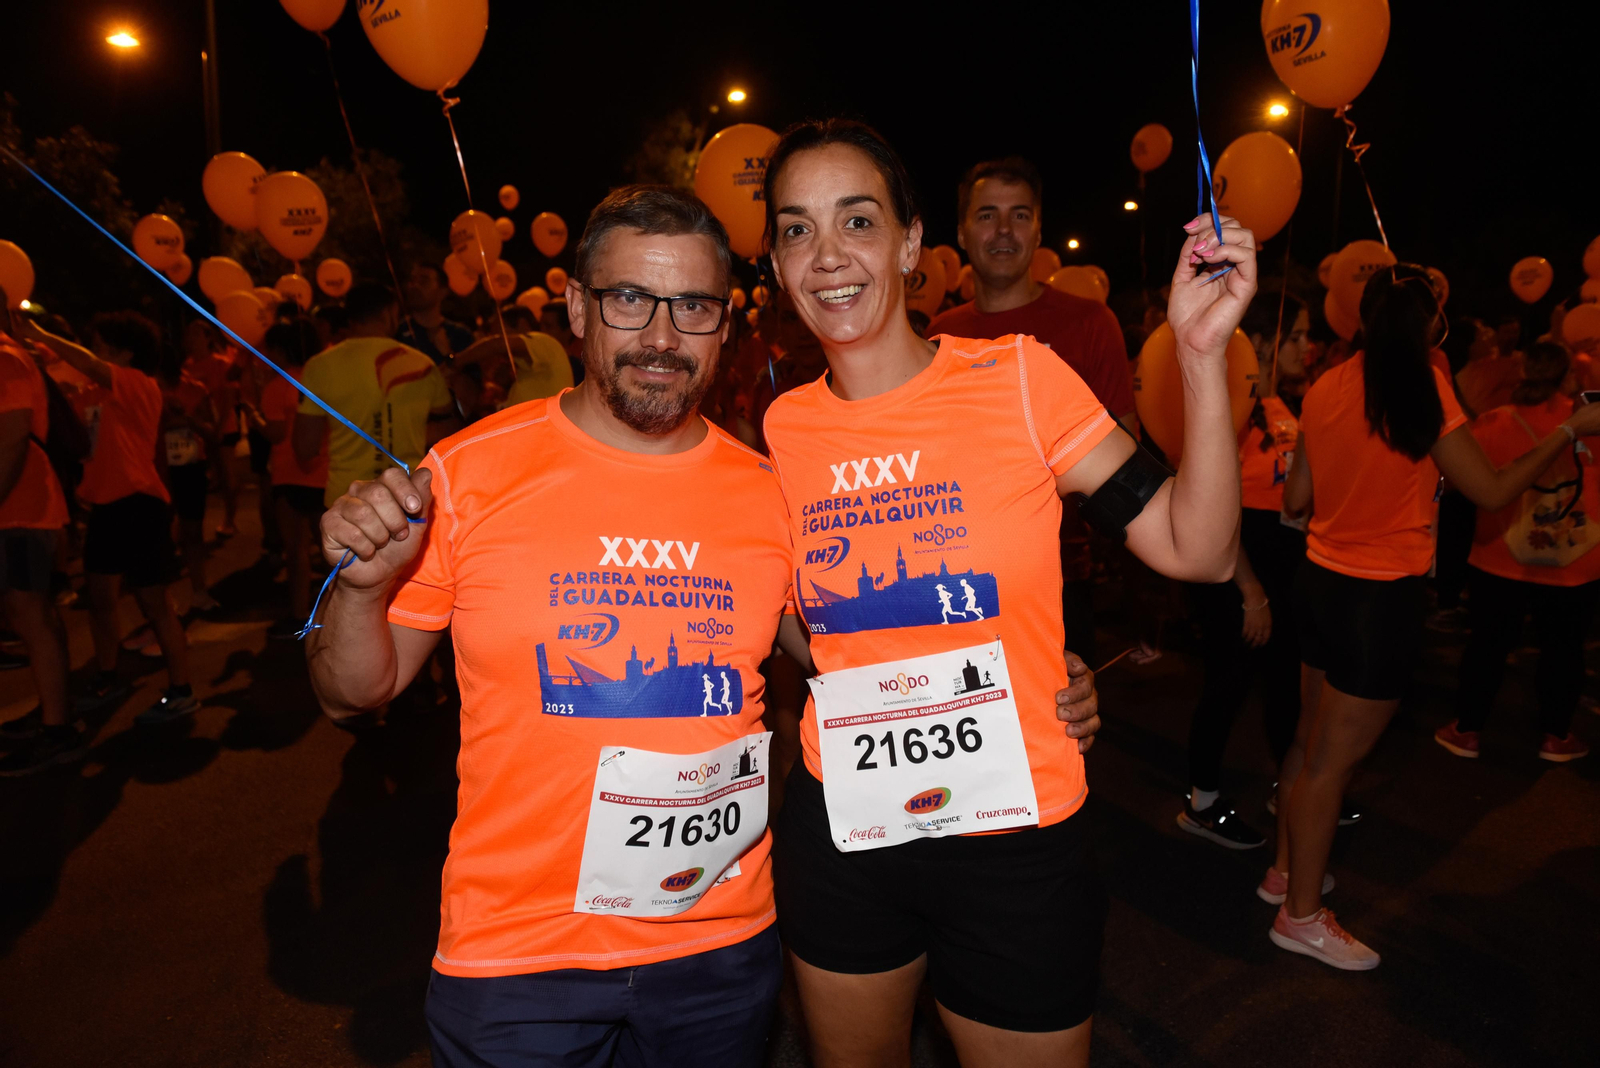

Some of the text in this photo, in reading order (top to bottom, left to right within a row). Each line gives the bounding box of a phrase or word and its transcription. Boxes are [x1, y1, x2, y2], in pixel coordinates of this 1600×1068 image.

[829, 450, 921, 494] XXXV
[802, 480, 962, 517] CARRERA NOCTURNA
[809, 497, 965, 533] GUADALQUIVIR
[598, 536, 700, 570] XXXV
[549, 571, 733, 592] CARRERA NOCTURNA
[550, 586, 735, 612] DEL GUADALQUIVIR
[545, 702, 574, 714] 2023
[827, 719, 844, 727] XXXV
[845, 715, 873, 724] CARRERA
[873, 711, 907, 721] NOCTURNA
[919, 699, 970, 714] GUADALQUIVIR
[971, 696, 985, 704] KH7
[985, 691, 1002, 700] 2023
[853, 716, 983, 770] 21636
[604, 793, 625, 802] XXXV
[625, 797, 658, 805] CARRERA
[707, 784, 740, 801] GUADALQUIVIR
[740, 780, 751, 788] KH7
[625, 801, 741, 847] 21630
[976, 806, 1028, 820] Cruzcampo
